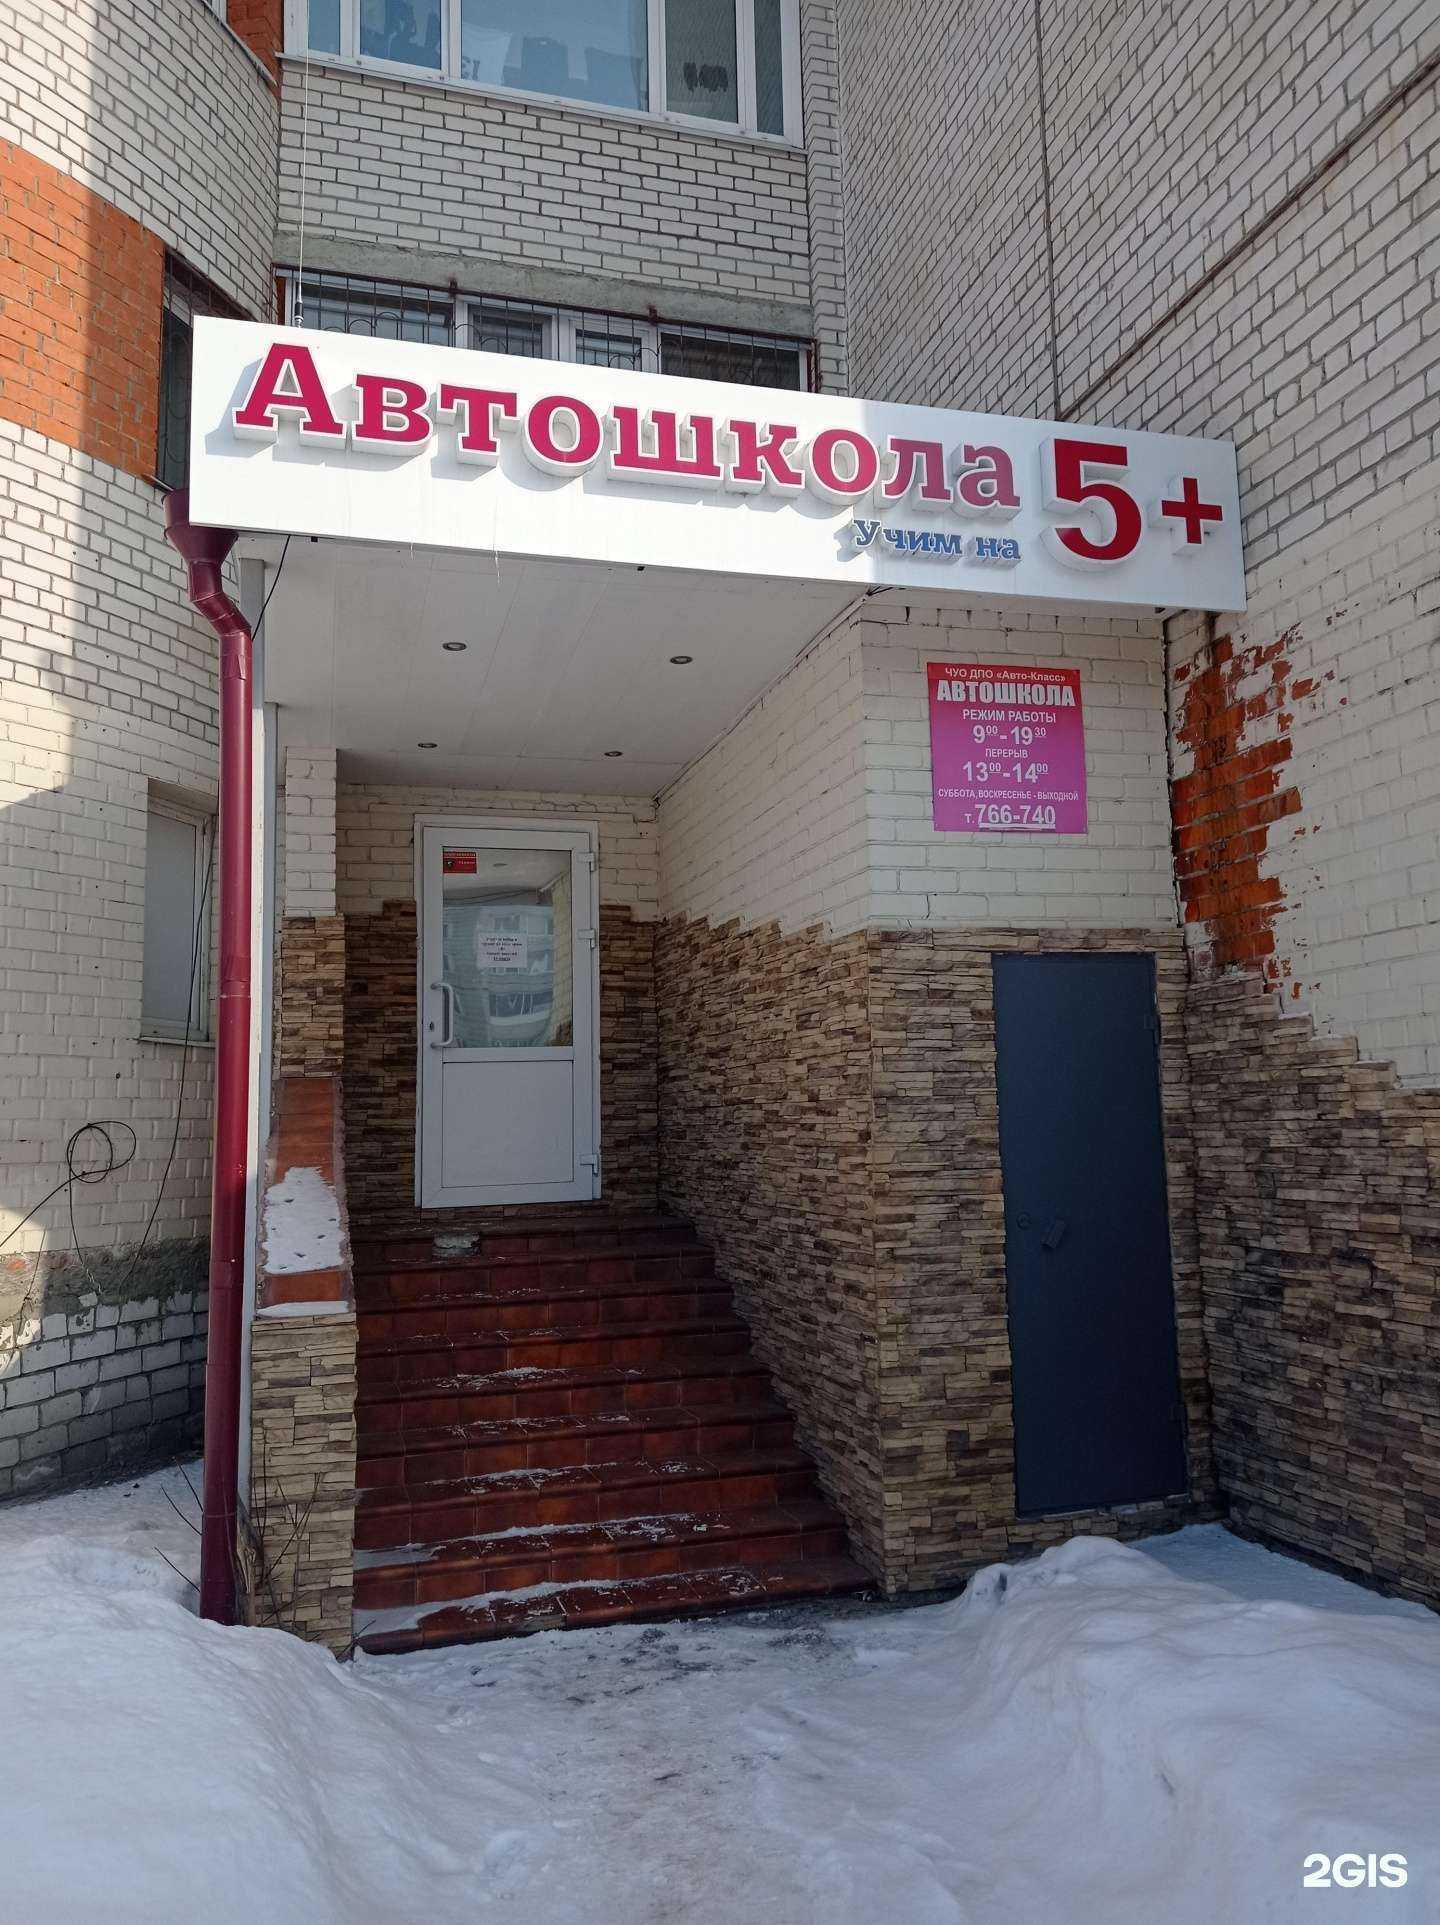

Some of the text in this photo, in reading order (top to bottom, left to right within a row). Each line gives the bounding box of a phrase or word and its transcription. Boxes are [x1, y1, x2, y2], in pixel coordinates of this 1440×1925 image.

[232, 341, 1021, 508] Автошкола
[853, 518, 963, 556] Учим
[975, 535, 1022, 561] на
[945, 667, 967, 678] ЧУО
[969, 668, 994, 680] ДПО
[936, 679, 1076, 707] АВТОШКОЛА
[962, 708, 1057, 724] РЕЖИМ РАБОТЫ
[985, 748, 1029, 759] ПЕРЕРЫВ
[1037, 790, 1079, 802] ВЫХОДНОЙ
